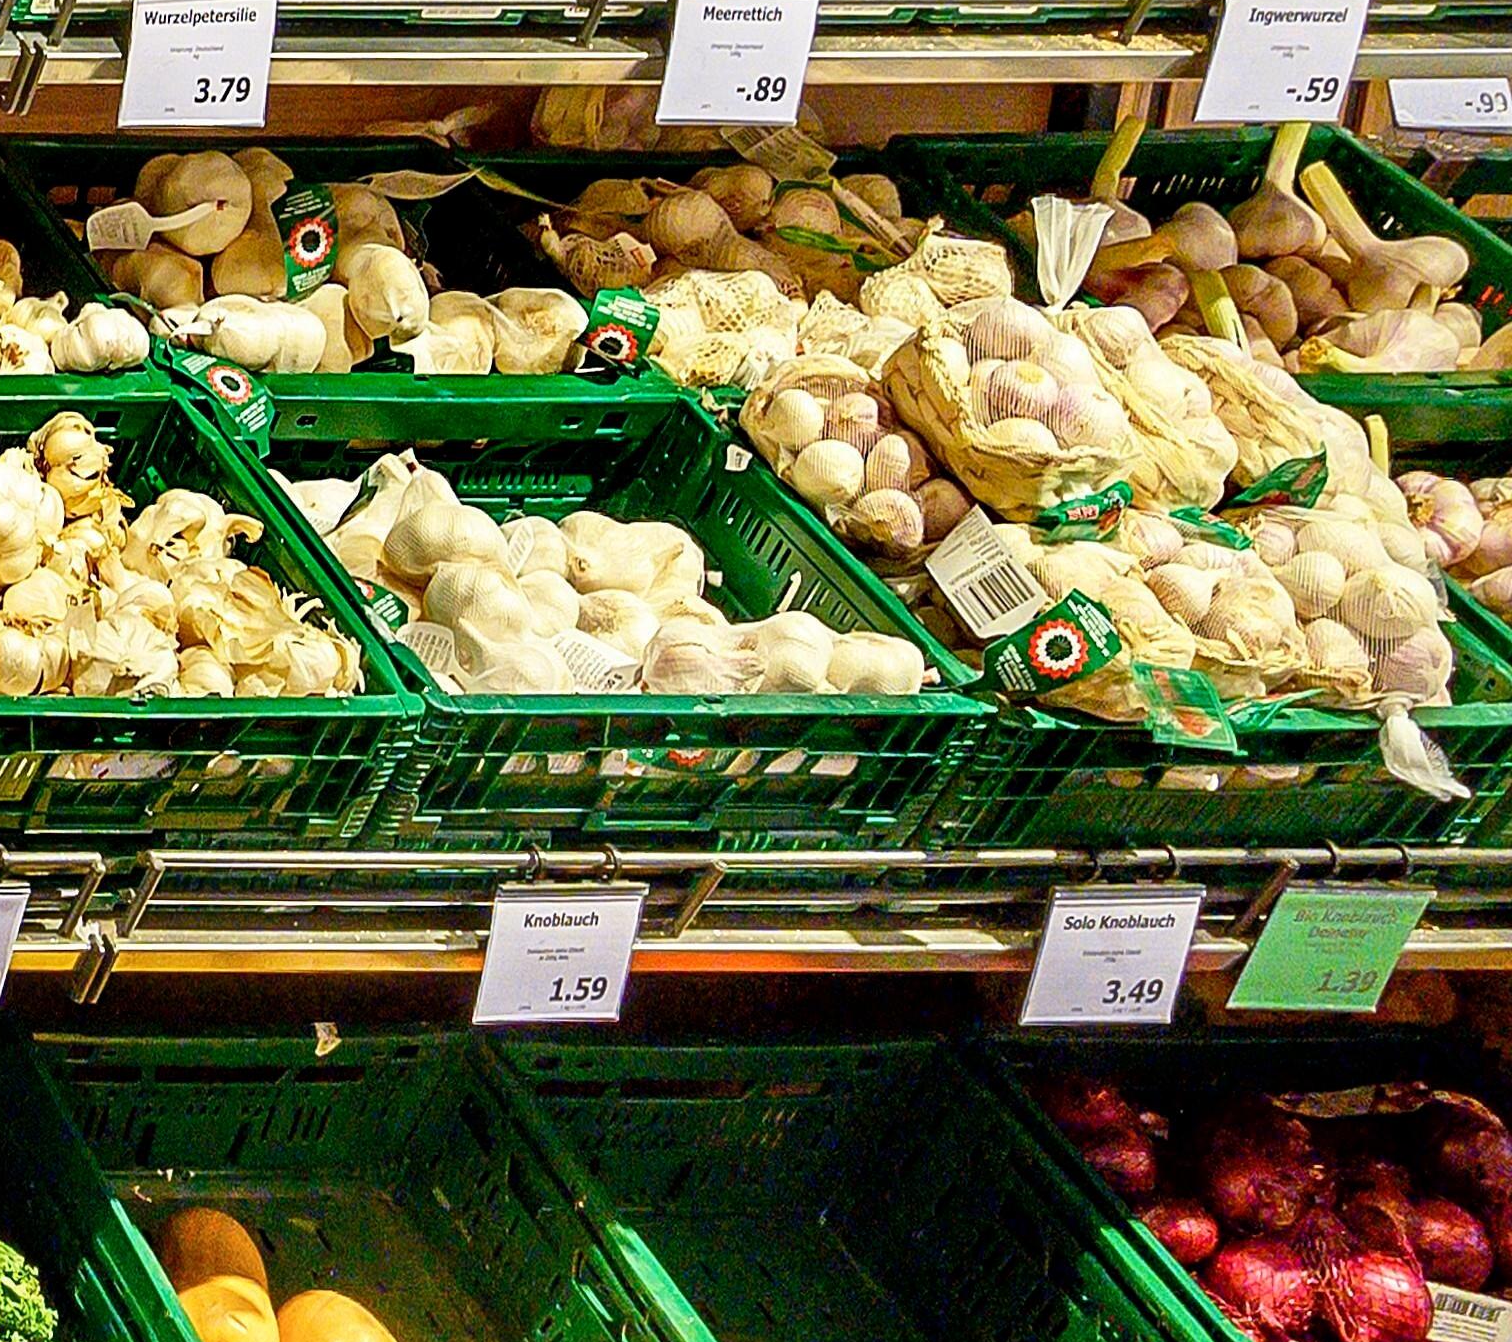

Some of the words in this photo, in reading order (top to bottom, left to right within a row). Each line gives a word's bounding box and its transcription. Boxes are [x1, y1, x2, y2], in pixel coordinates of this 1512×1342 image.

[144, 7, 257, 28] Wurzelpetersilie
[703, 5, 783, 22] Meerrettich
[1248, 7, 1349, 26] Ingwerwurzel
[194, 76, 251, 104] 3.79
[736, 76, 787, 102] -.89
[1286, 77, 1340, 103] -.59
[523, 911, 599, 929] Knoblauch
[1063, 915, 1097, 931] Solo
[1098, 913, 1176, 930] Knoblauch
[548, 976, 608, 1002] 1.59
[1101, 978, 1164, 1004] 3.49
[1317, 969, 1378, 994] 1.39
